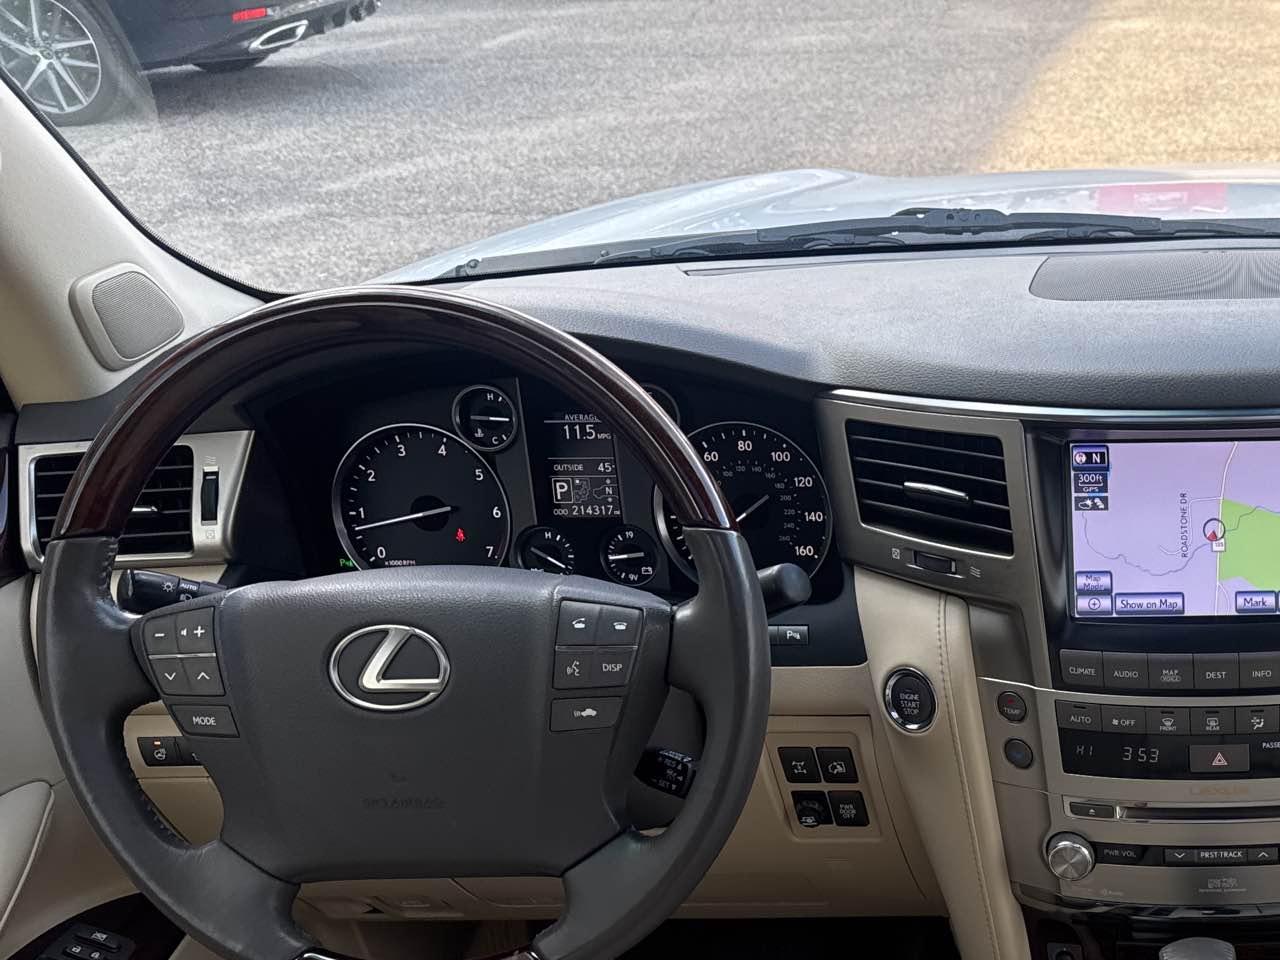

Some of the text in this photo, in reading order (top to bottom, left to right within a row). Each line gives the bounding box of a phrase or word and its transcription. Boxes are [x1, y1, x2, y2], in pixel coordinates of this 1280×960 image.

[563, 424, 596, 440] 11.5
[491, 436, 499, 444] C
[737, 440, 753, 451] 80
[397, 444, 406, 456] 3
[437, 444, 447, 456] 4
[703, 451, 719, 462] 60
[771, 451, 791, 462] 100
[1092, 453, 1101, 463] N
[366, 469, 376, 482] 2
[475, 469, 484, 481] 5
[1078, 474, 1103, 483] 300ft
[794, 477, 813, 487] 120
[555, 482, 568, 500] P
[358, 507, 365, 519] 1
[492, 506, 501, 518] 6
[572, 505, 613, 516] 214317
[804, 511, 823, 522] 140
[1179, 492, 1189, 558] ROADSTONE DR
[544, 531, 552, 539] H
[376, 546, 386, 559] 0
[485, 546, 494, 558] 7
[795, 545, 814, 556] 160
[180, 582, 198, 591] AUTO
[1120, 599, 1144, 609] Show
[1159, 599, 1178, 611] Map
[1243, 597, 1267, 608] Mark
[602, 663, 622, 673] DISP
[1069, 667, 1097, 676] CLIMATE
[1113, 670, 1139, 678] AUDIO
[1205, 671, 1227, 679] DEST
[1252, 670, 1272, 678] INFO
[900, 692, 920, 700] ENGINE
[900, 700, 920, 708] START
[903, 707, 920, 715] STOP
[192, 716, 217, 726] MODE
[1070, 715, 1092, 724] AUTO
[1120, 718, 1136, 727] OFF
